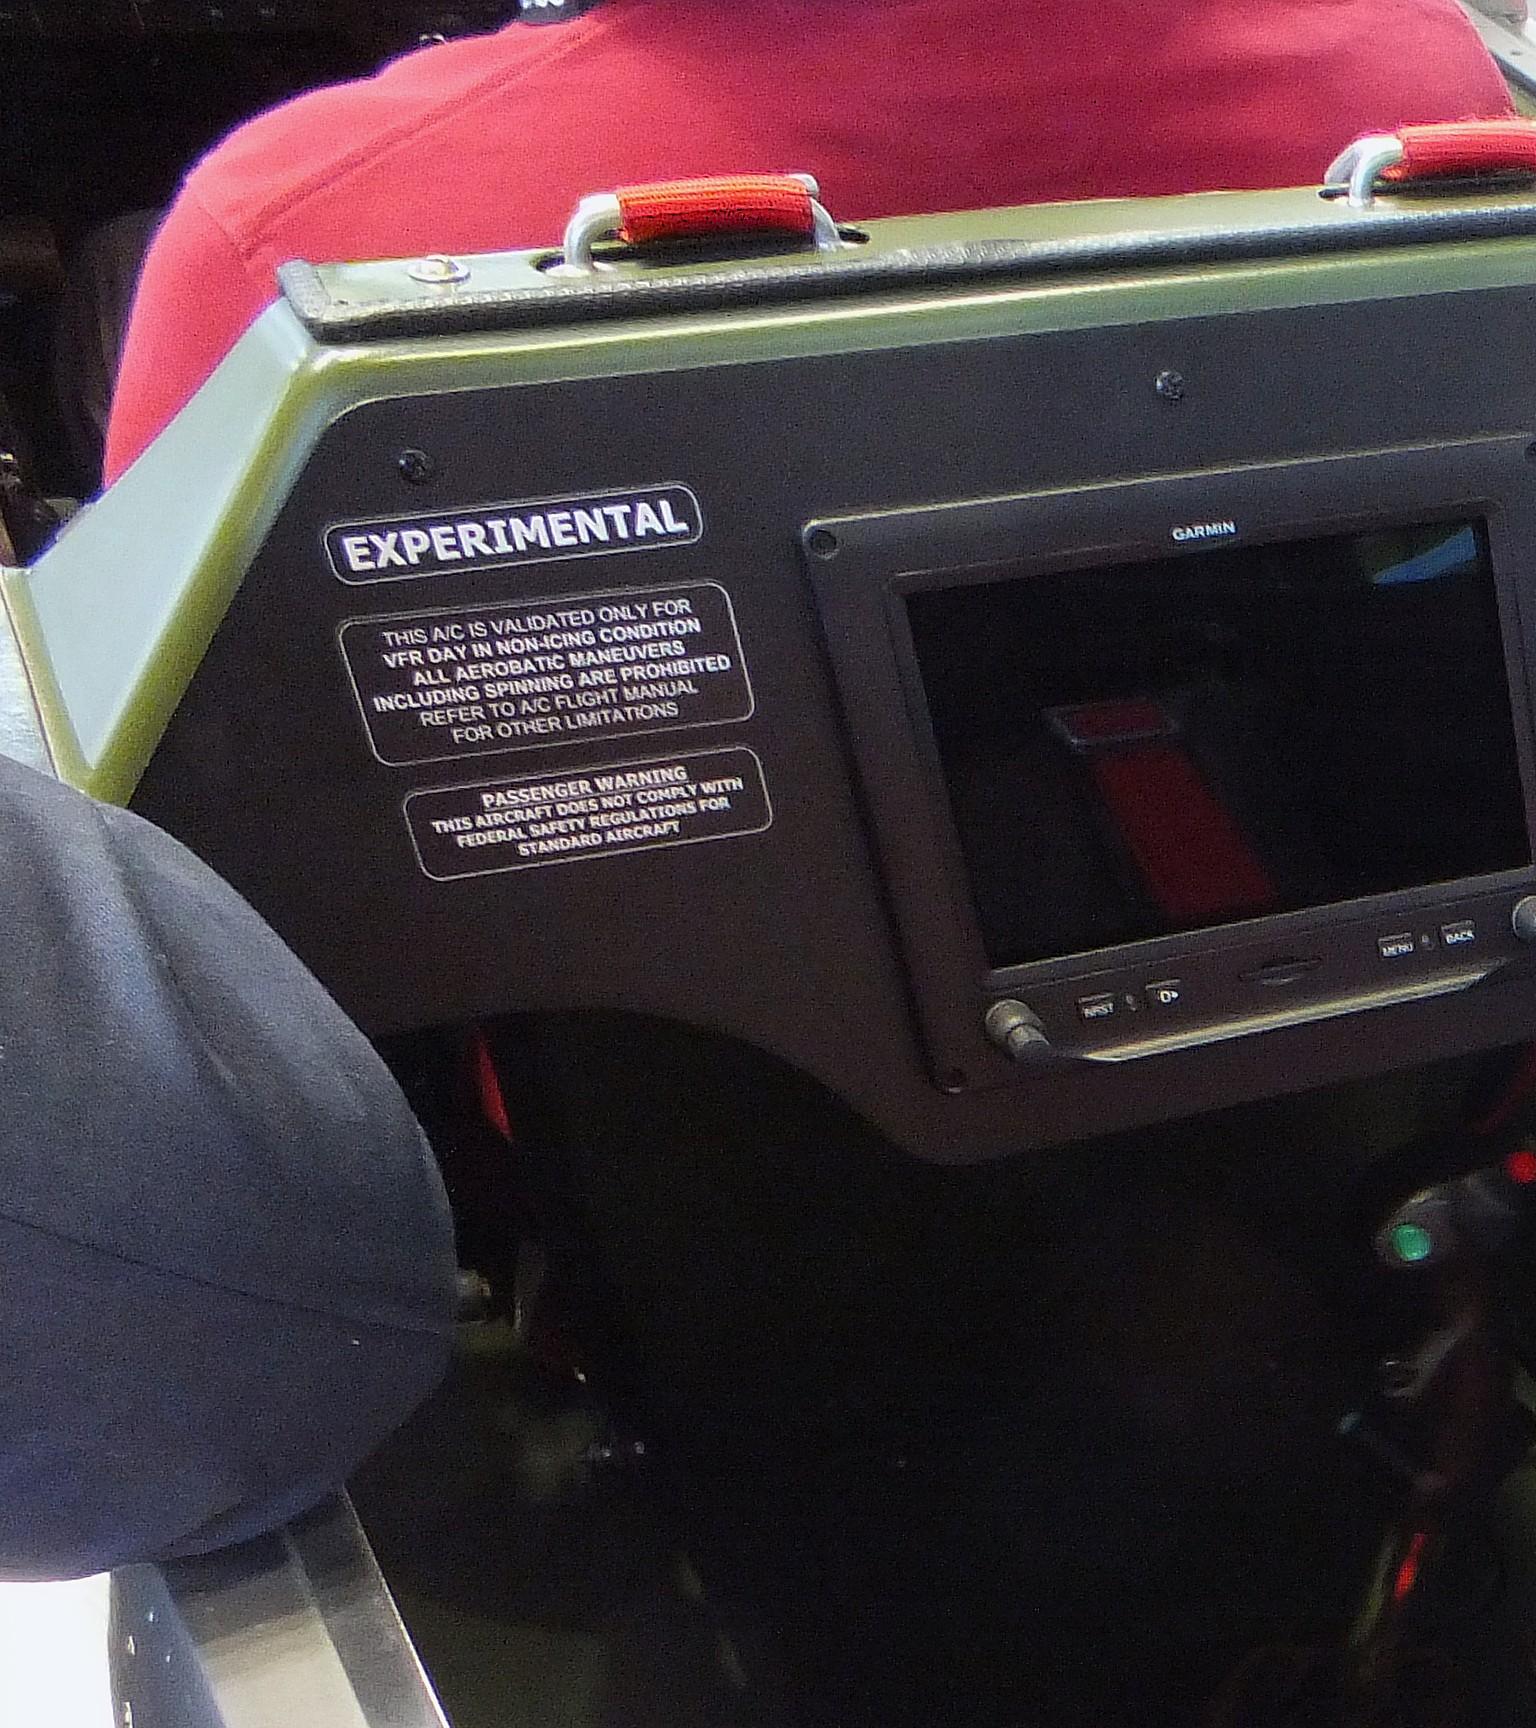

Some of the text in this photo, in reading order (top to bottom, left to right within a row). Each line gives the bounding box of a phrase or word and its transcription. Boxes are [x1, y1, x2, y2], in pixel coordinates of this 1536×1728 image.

[341, 499, 689, 571] EXPERIMENTAL
[1171, 520, 1237, 541] GARMIN
[381, 628, 429, 647] THIS
[467, 621, 488, 638] IS
[490, 609, 595, 636] VALIDATED
[598, 603, 648, 623] ONLY
[651, 598, 693, 617] FOR
[382, 617, 702, 668] VFR DAY IN NON-ICING CONDITION
[372, 655, 731, 712] INCLUDING SPINNING ARE PROHIBITED
[413, 640, 686, 686] ALL AEROBATIC MANEUVERS
[419, 705, 487, 727] REFER
[487, 701, 516, 718] TO
[554, 688, 619, 710] FLIGHT
[622, 679, 699, 702] MANUAL
[450, 701, 679, 744] FOR OTHER LIMITATIONS
[431, 776, 744, 834] THIS AIRCRAFT DOES NOT COMPLY WITH
[481, 765, 689, 808] PASSENGER WARNING
[456, 796, 731, 848] FEDERAL SAFETY REGULATIONS FOR
[517, 820, 680, 856] STANDARD AIRCRAFT
[1382, 942, 1415, 958] MENU
